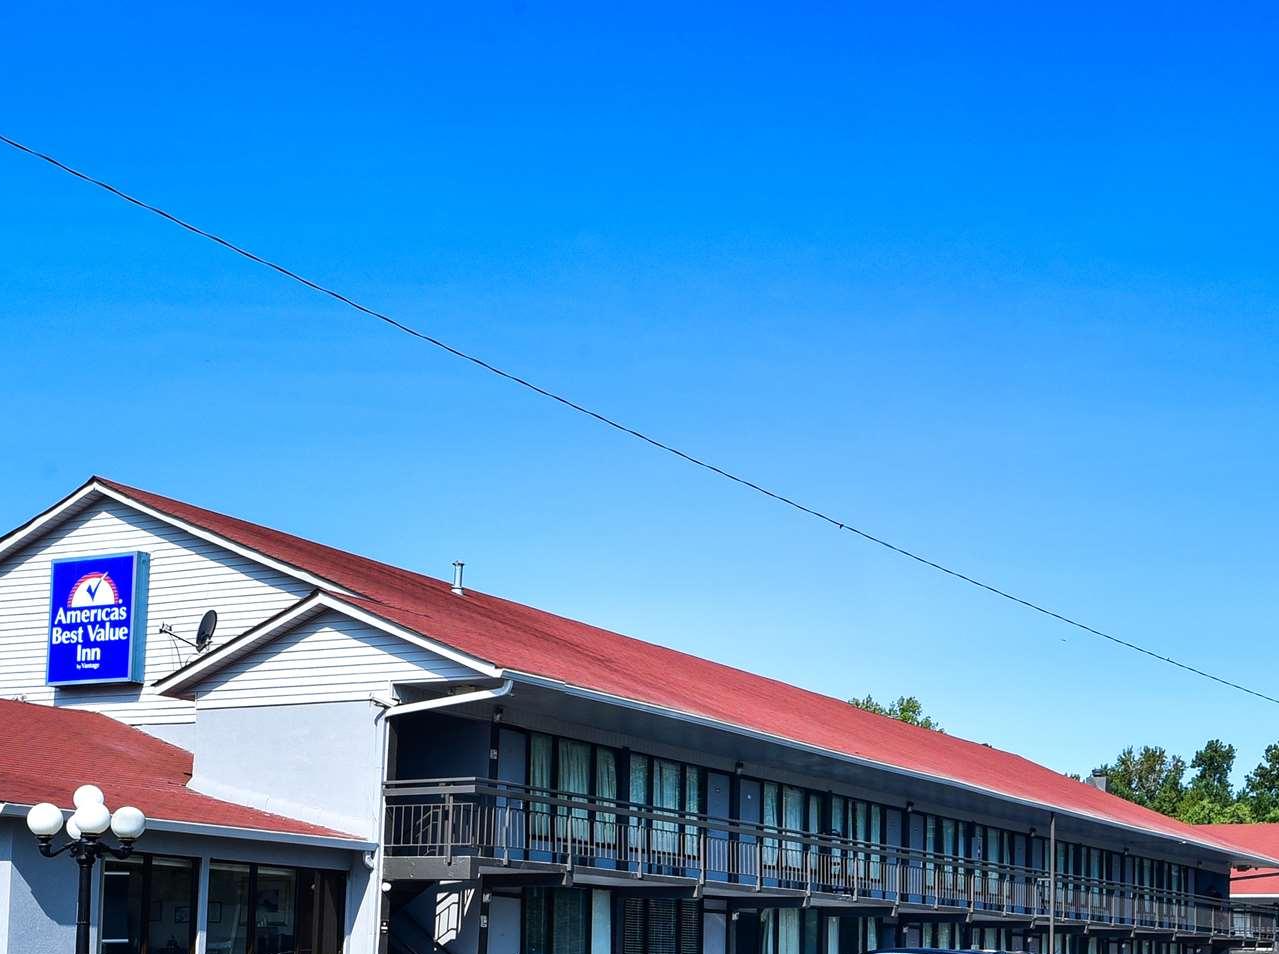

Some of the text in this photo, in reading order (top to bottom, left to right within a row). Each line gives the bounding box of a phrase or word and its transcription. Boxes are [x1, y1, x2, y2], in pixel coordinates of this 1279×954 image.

[54, 607, 127, 625] Americas
[51, 622, 129, 645] Best Value
[76, 644, 101, 662] Inn
